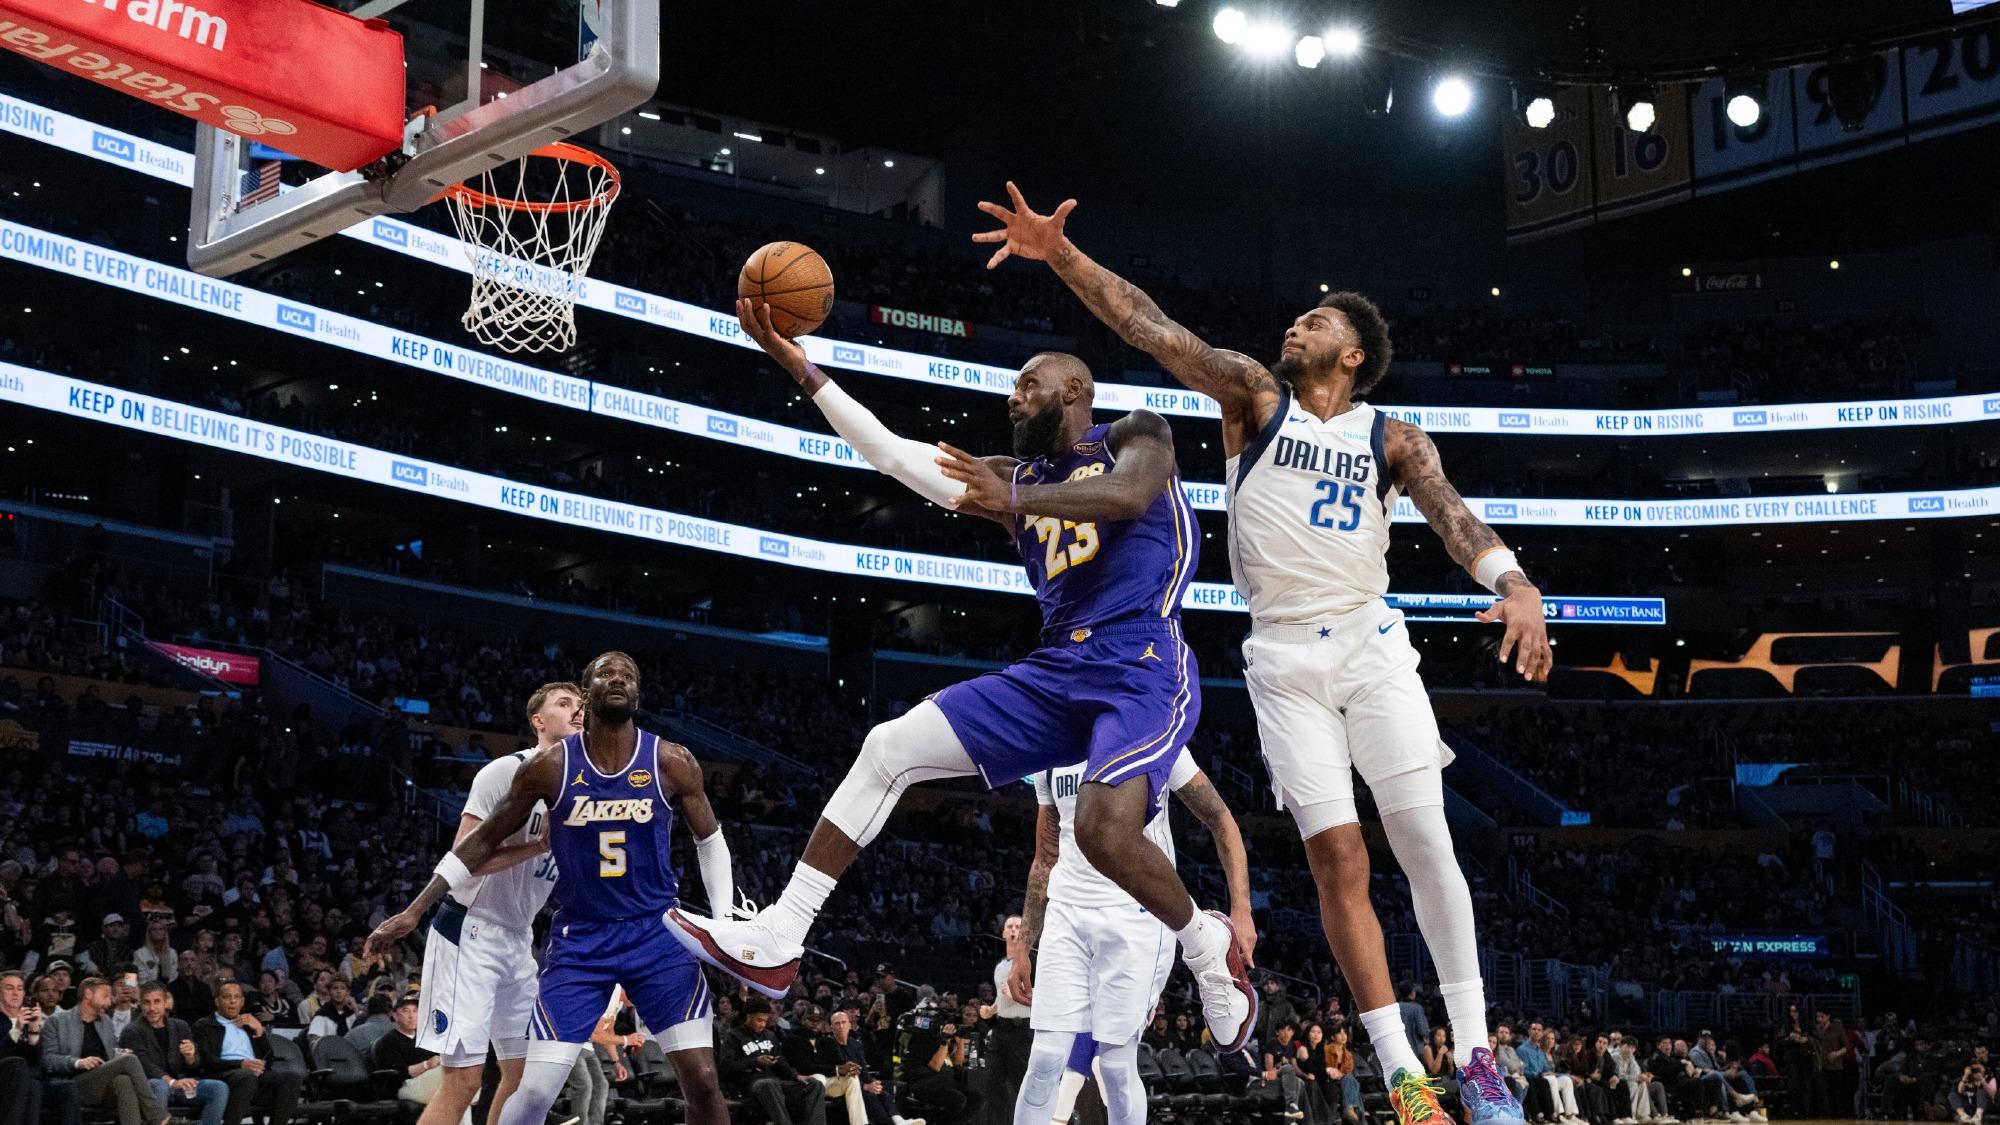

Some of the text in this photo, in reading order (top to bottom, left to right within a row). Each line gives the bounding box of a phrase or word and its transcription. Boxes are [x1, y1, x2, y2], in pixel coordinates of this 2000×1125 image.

[104, 0, 228, 51] arm
[1514, 141, 1578, 205] 30
[83, 250, 140, 283] EVERY
[145, 267, 243, 312] CHALLENGE
[710, 317, 740, 337] KEEP
[878, 306, 967, 337] TOSHIBA
[392, 335, 681, 424] KEEP ON OVERCOMING EVERY CHALLENGE
[929, 362, 1017, 390] KEEP ON RISIN
[1463, 366, 1490, 374] TOYOTA
[1526, 367, 1553, 375] TOYOTA
[1146, 392, 1178, 409] KEEP
[1183, 396, 1200, 411] ON
[1838, 402, 1952, 422] KEEP ON RISING
[69, 385, 357, 470] KEEP ON BELIEVING IT'S POSSIBLE
[1427, 412, 1471, 427] RISING
[1596, 413, 1704, 430] KEEP ON RISING
[799, 436, 831, 456] KEEP
[836, 443, 853, 461] ON
[1273, 435, 1372, 483] DALLAS
[1187, 487, 1220, 504] KEEP
[1309, 479, 1366, 532] 25
[1585, 498, 1877, 521] KEEP ON OVERCOMING EVERY CHALLENGE
[501, 485, 731, 547] KEEP ON BELIEVING IT'S POSSIBLE
[1036, 517, 1100, 581] 23
[856, 551, 890, 571] KEEP
[895, 555, 913, 575] ON
[917, 559, 984, 584] BELIEVING
[988, 568, 1011, 586] IT'S
[1193, 588, 1226, 604] KEEP
[1397, 595, 1427, 605] Happy
[1429, 595, 1467, 606] Birthday
[564, 796, 654, 826] LAKERS
[599, 830, 628, 878] 5
[1756, 941, 1817, 953] EXPRESS
